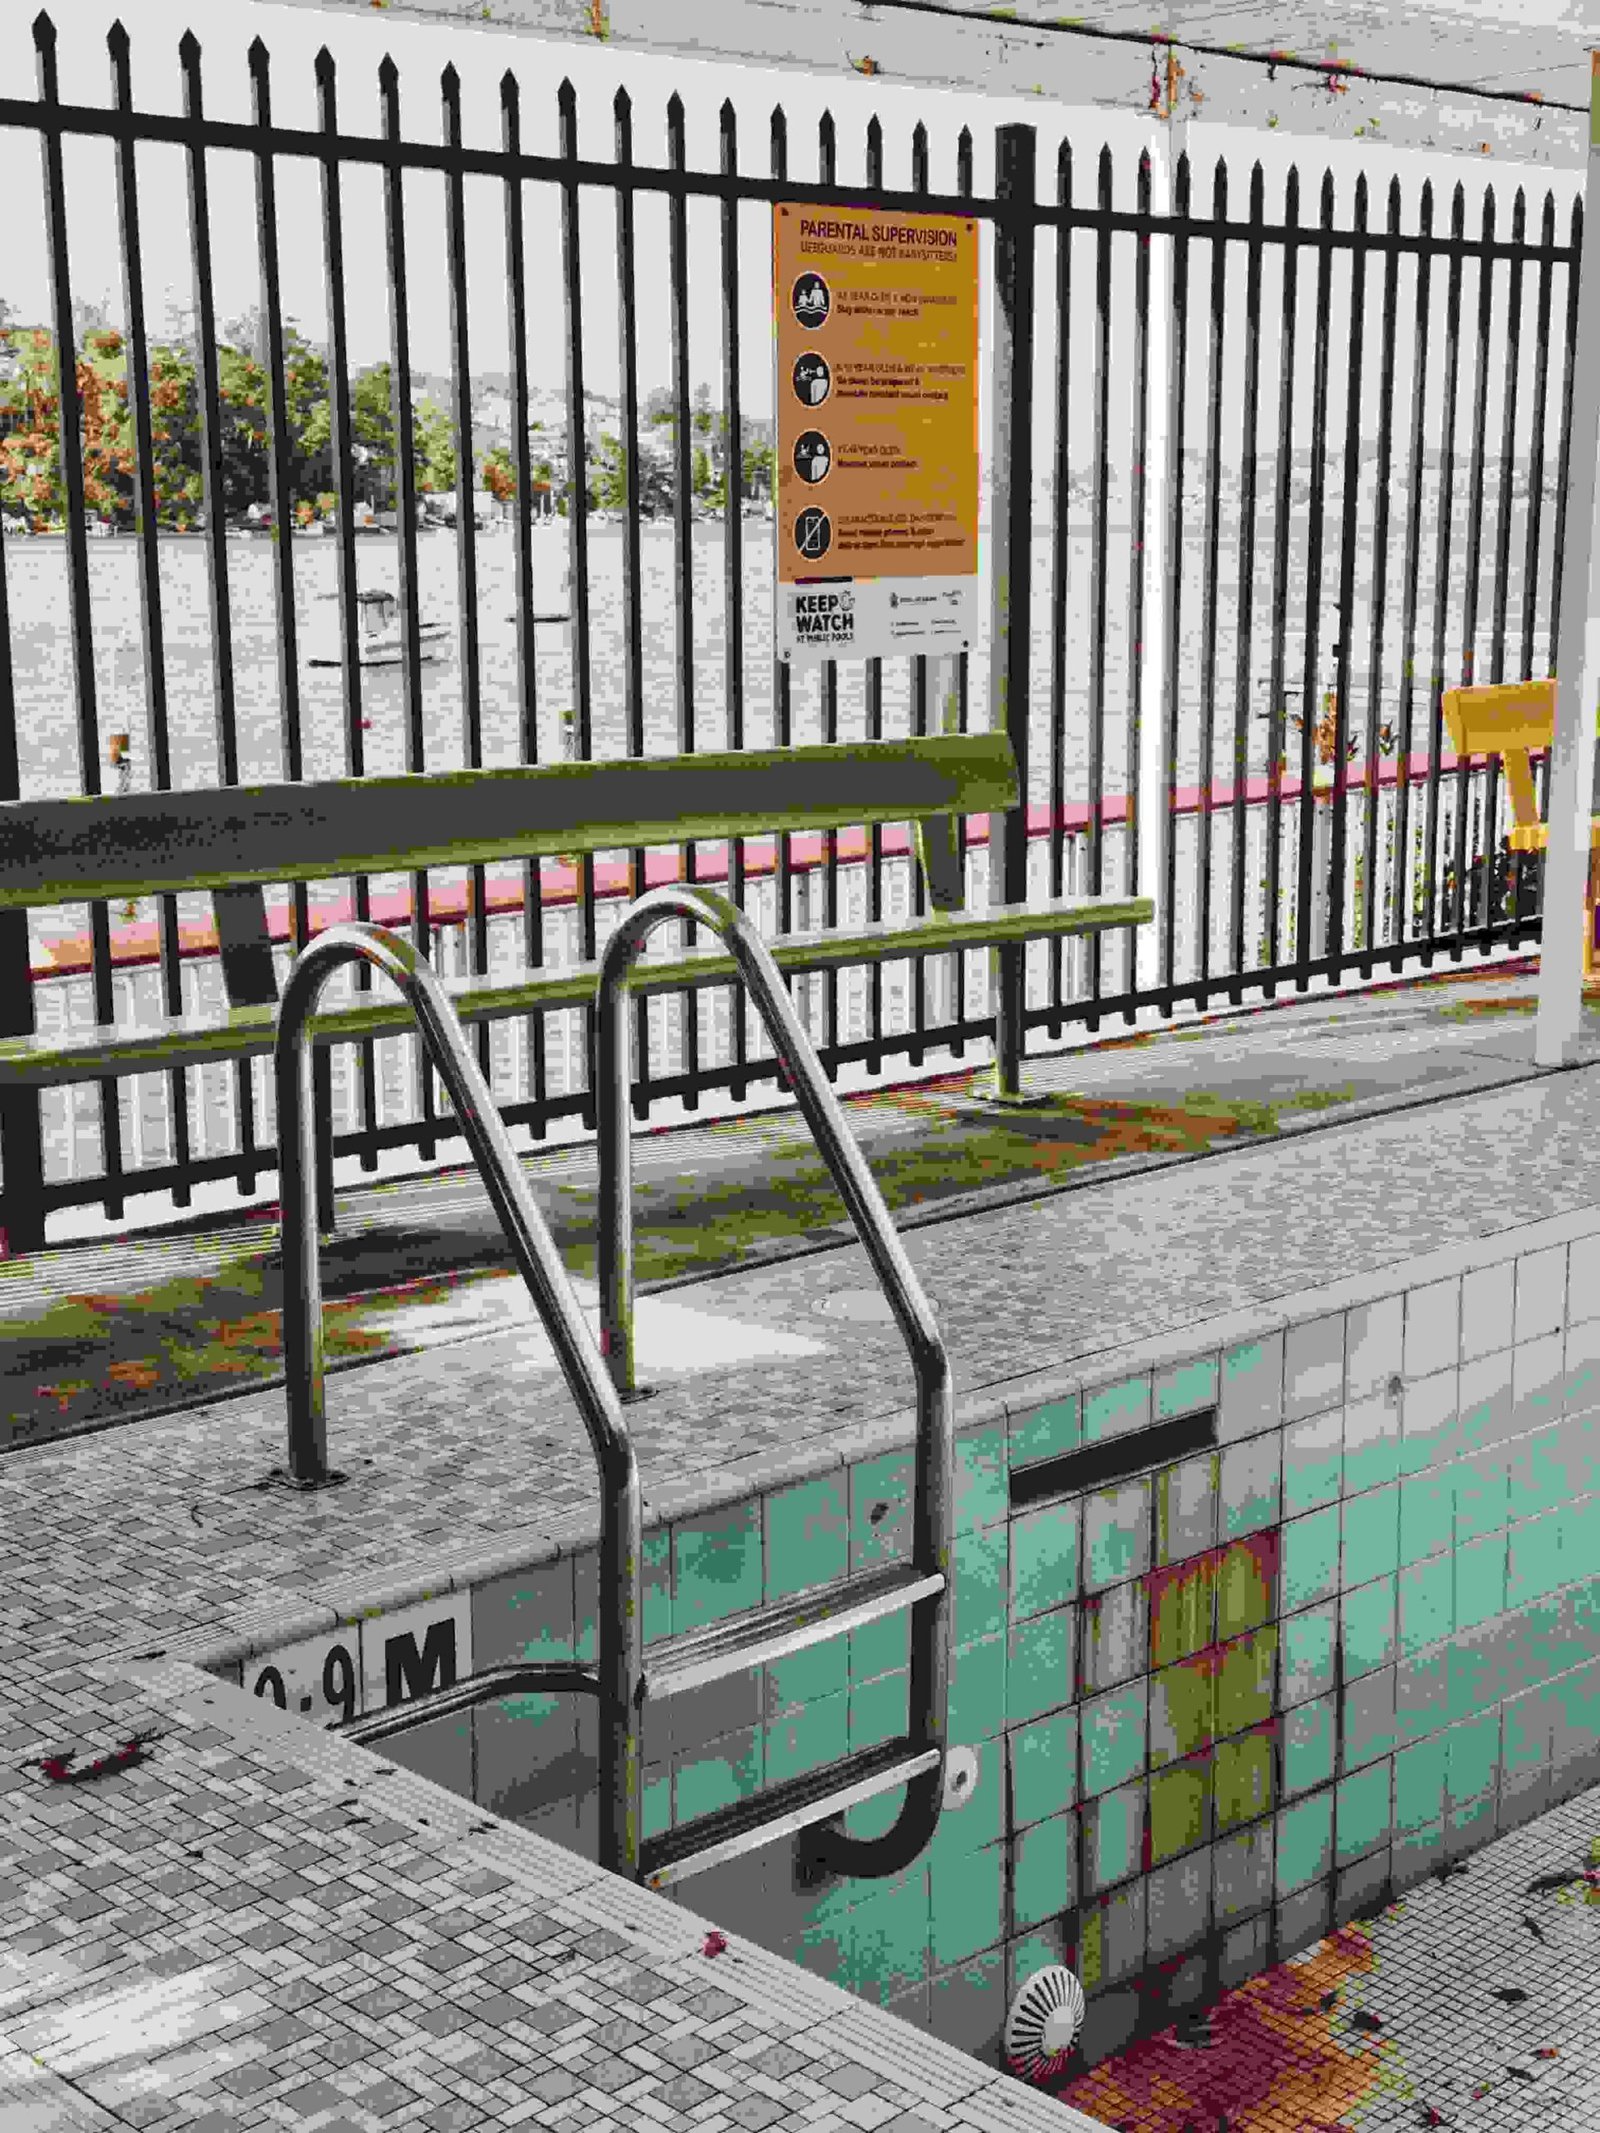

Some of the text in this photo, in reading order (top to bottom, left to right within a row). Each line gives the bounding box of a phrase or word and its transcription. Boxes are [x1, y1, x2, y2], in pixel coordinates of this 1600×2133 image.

[800, 219, 957, 247] PARENTAL SUPERVISION
[858, 245, 875, 257] ARE
[877, 246, 897, 259] NOT
[796, 595, 839, 613] KEEP
[796, 613, 854, 633] WATCH
[832, 632, 854, 642] POOLS
[384, 1617, 457, 1708] M
